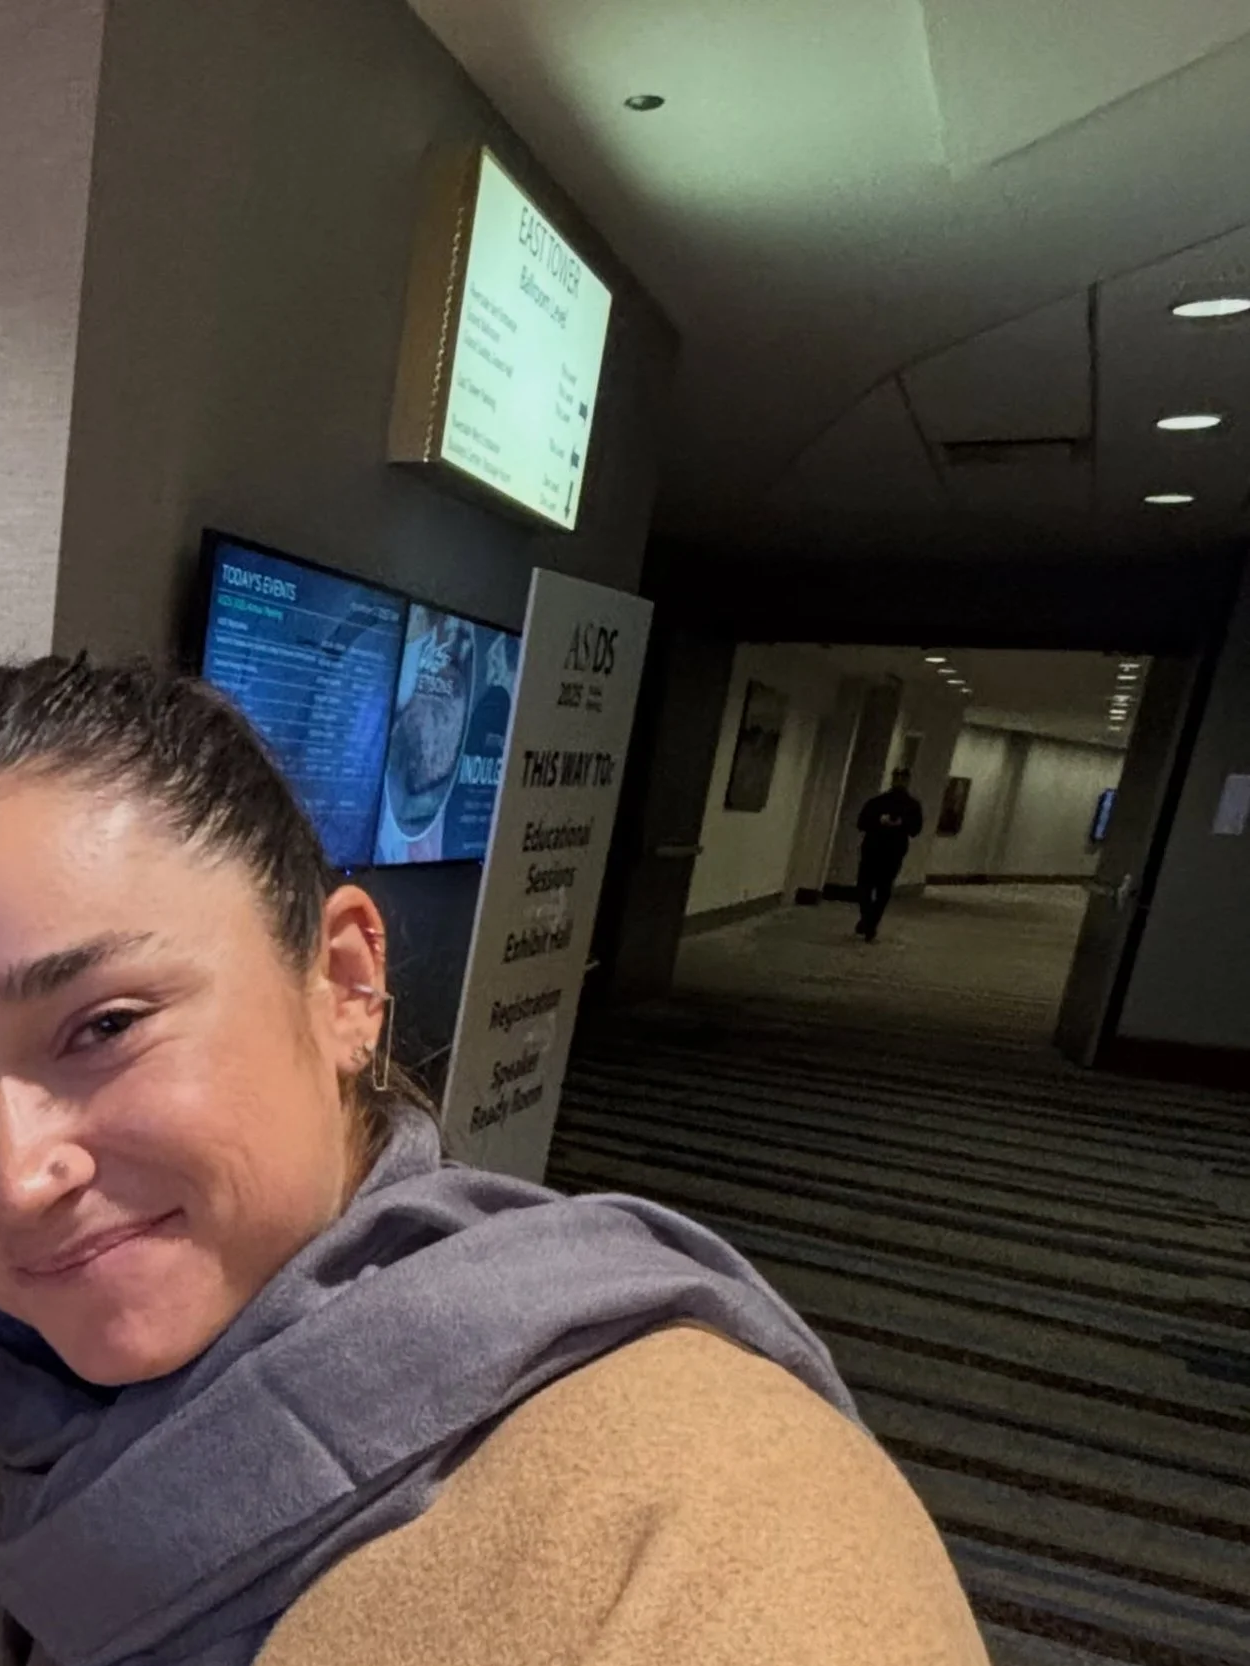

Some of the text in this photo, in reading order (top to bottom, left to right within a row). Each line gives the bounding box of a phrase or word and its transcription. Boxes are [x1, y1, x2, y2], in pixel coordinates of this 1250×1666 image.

[519, 206, 582, 299] EAST TOWER
[222, 563, 297, 601] TODAY'S EVENTS
[522, 750, 559, 788] THIS
[559, 750, 594, 788] WAY
[521, 816, 595, 852] Educational
